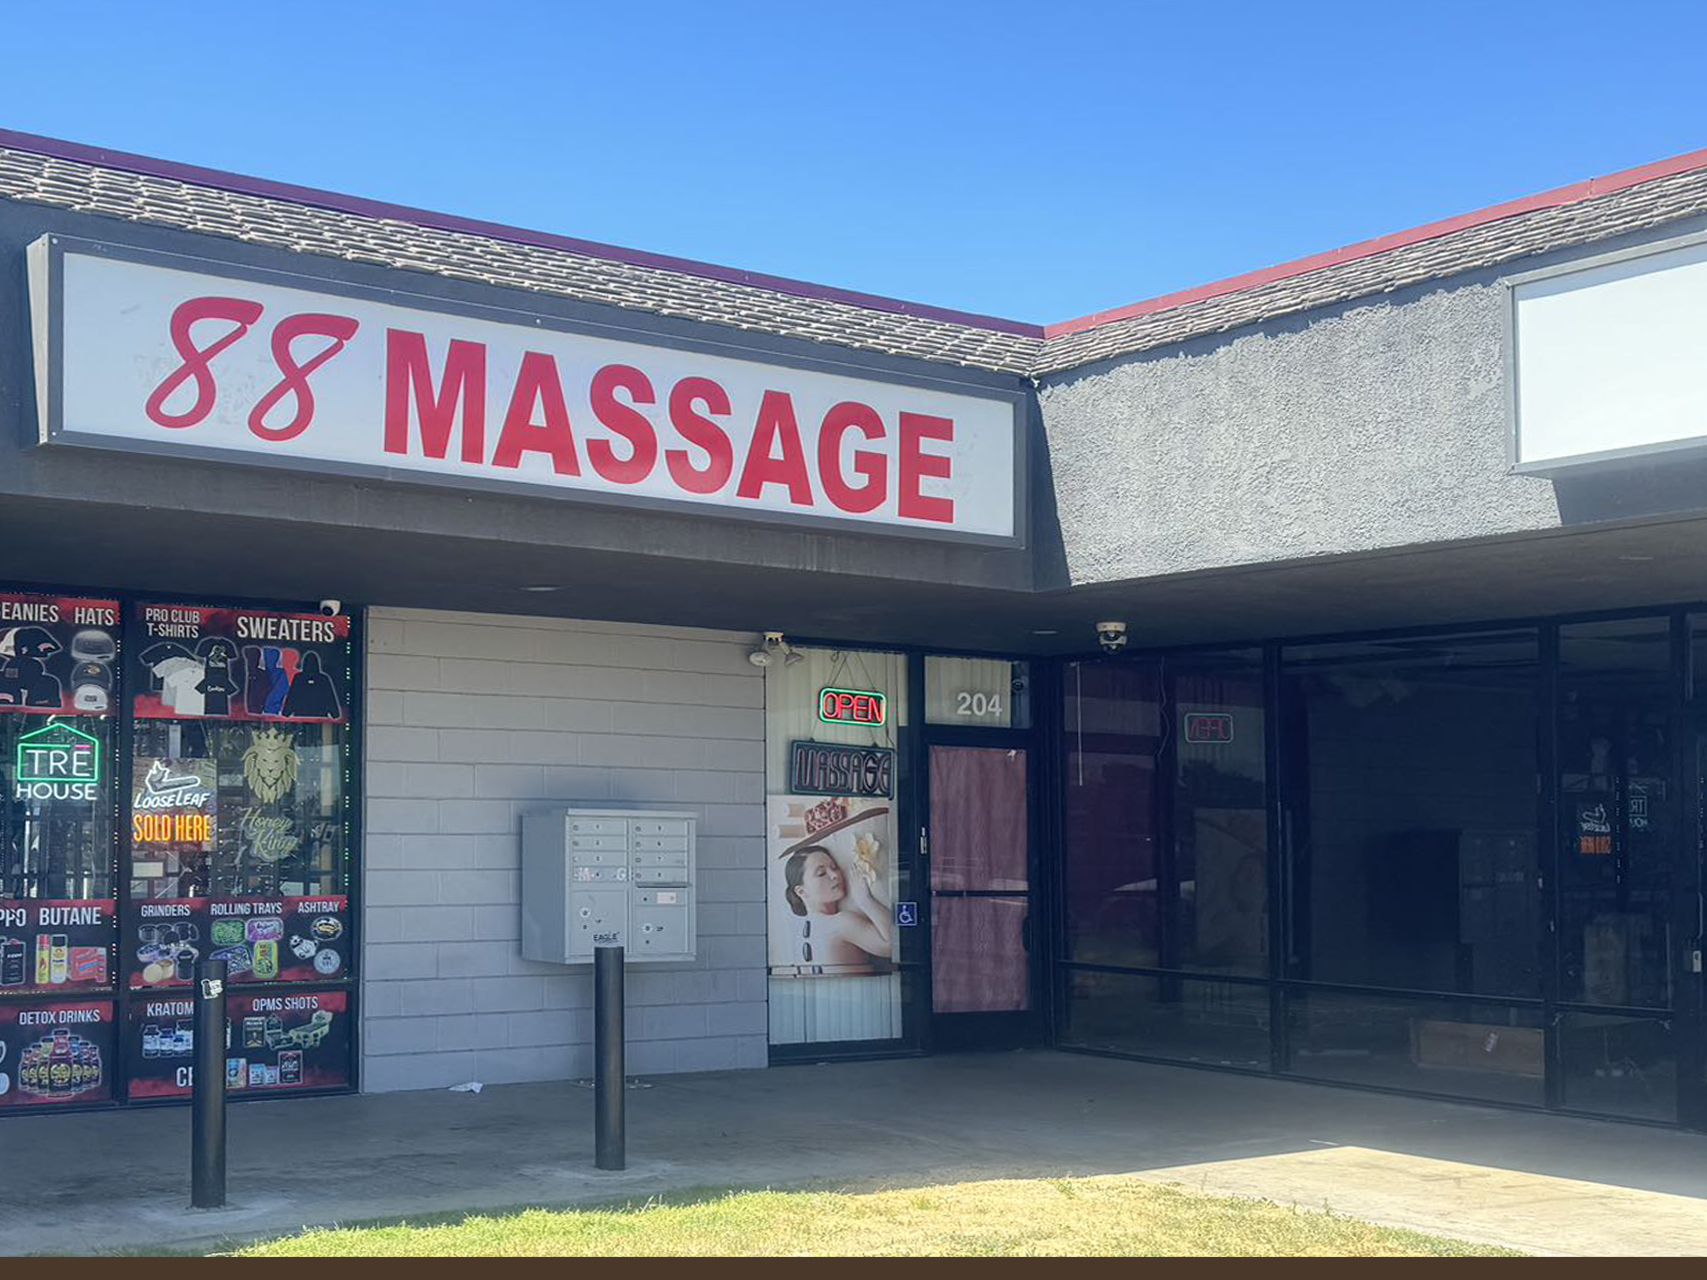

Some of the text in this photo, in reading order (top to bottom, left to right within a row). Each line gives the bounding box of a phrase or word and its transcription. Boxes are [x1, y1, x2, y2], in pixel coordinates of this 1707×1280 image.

[147, 297, 955, 525] 88 MASSAGE
[74, 606, 115, 626] HATS
[145, 607, 200, 624] PRO CLUB
[146, 622, 199, 639] T-SHIRTS
[236, 615, 335, 643] SWEATERS
[823, 692, 883, 723] OPEN
[956, 692, 1004, 717] 204
[25, 749, 91, 777] TRE
[796, 746, 892, 795] MASSAGE
[15, 782, 98, 800] HOUSE
[133, 814, 211, 842] SOLD HERE
[39, 906, 102, 926] BUTANE
[141, 904, 191, 918] GRINDERS
[210, 901, 283, 916] ROLLING TRAYS
[297, 901, 340, 914] ASHTRAY
[146, 1001, 194, 1017] KRATOM
[252, 996, 319, 1012] OPMS SHOTS
[19, 1009, 101, 1025] DETOX DRINKS
